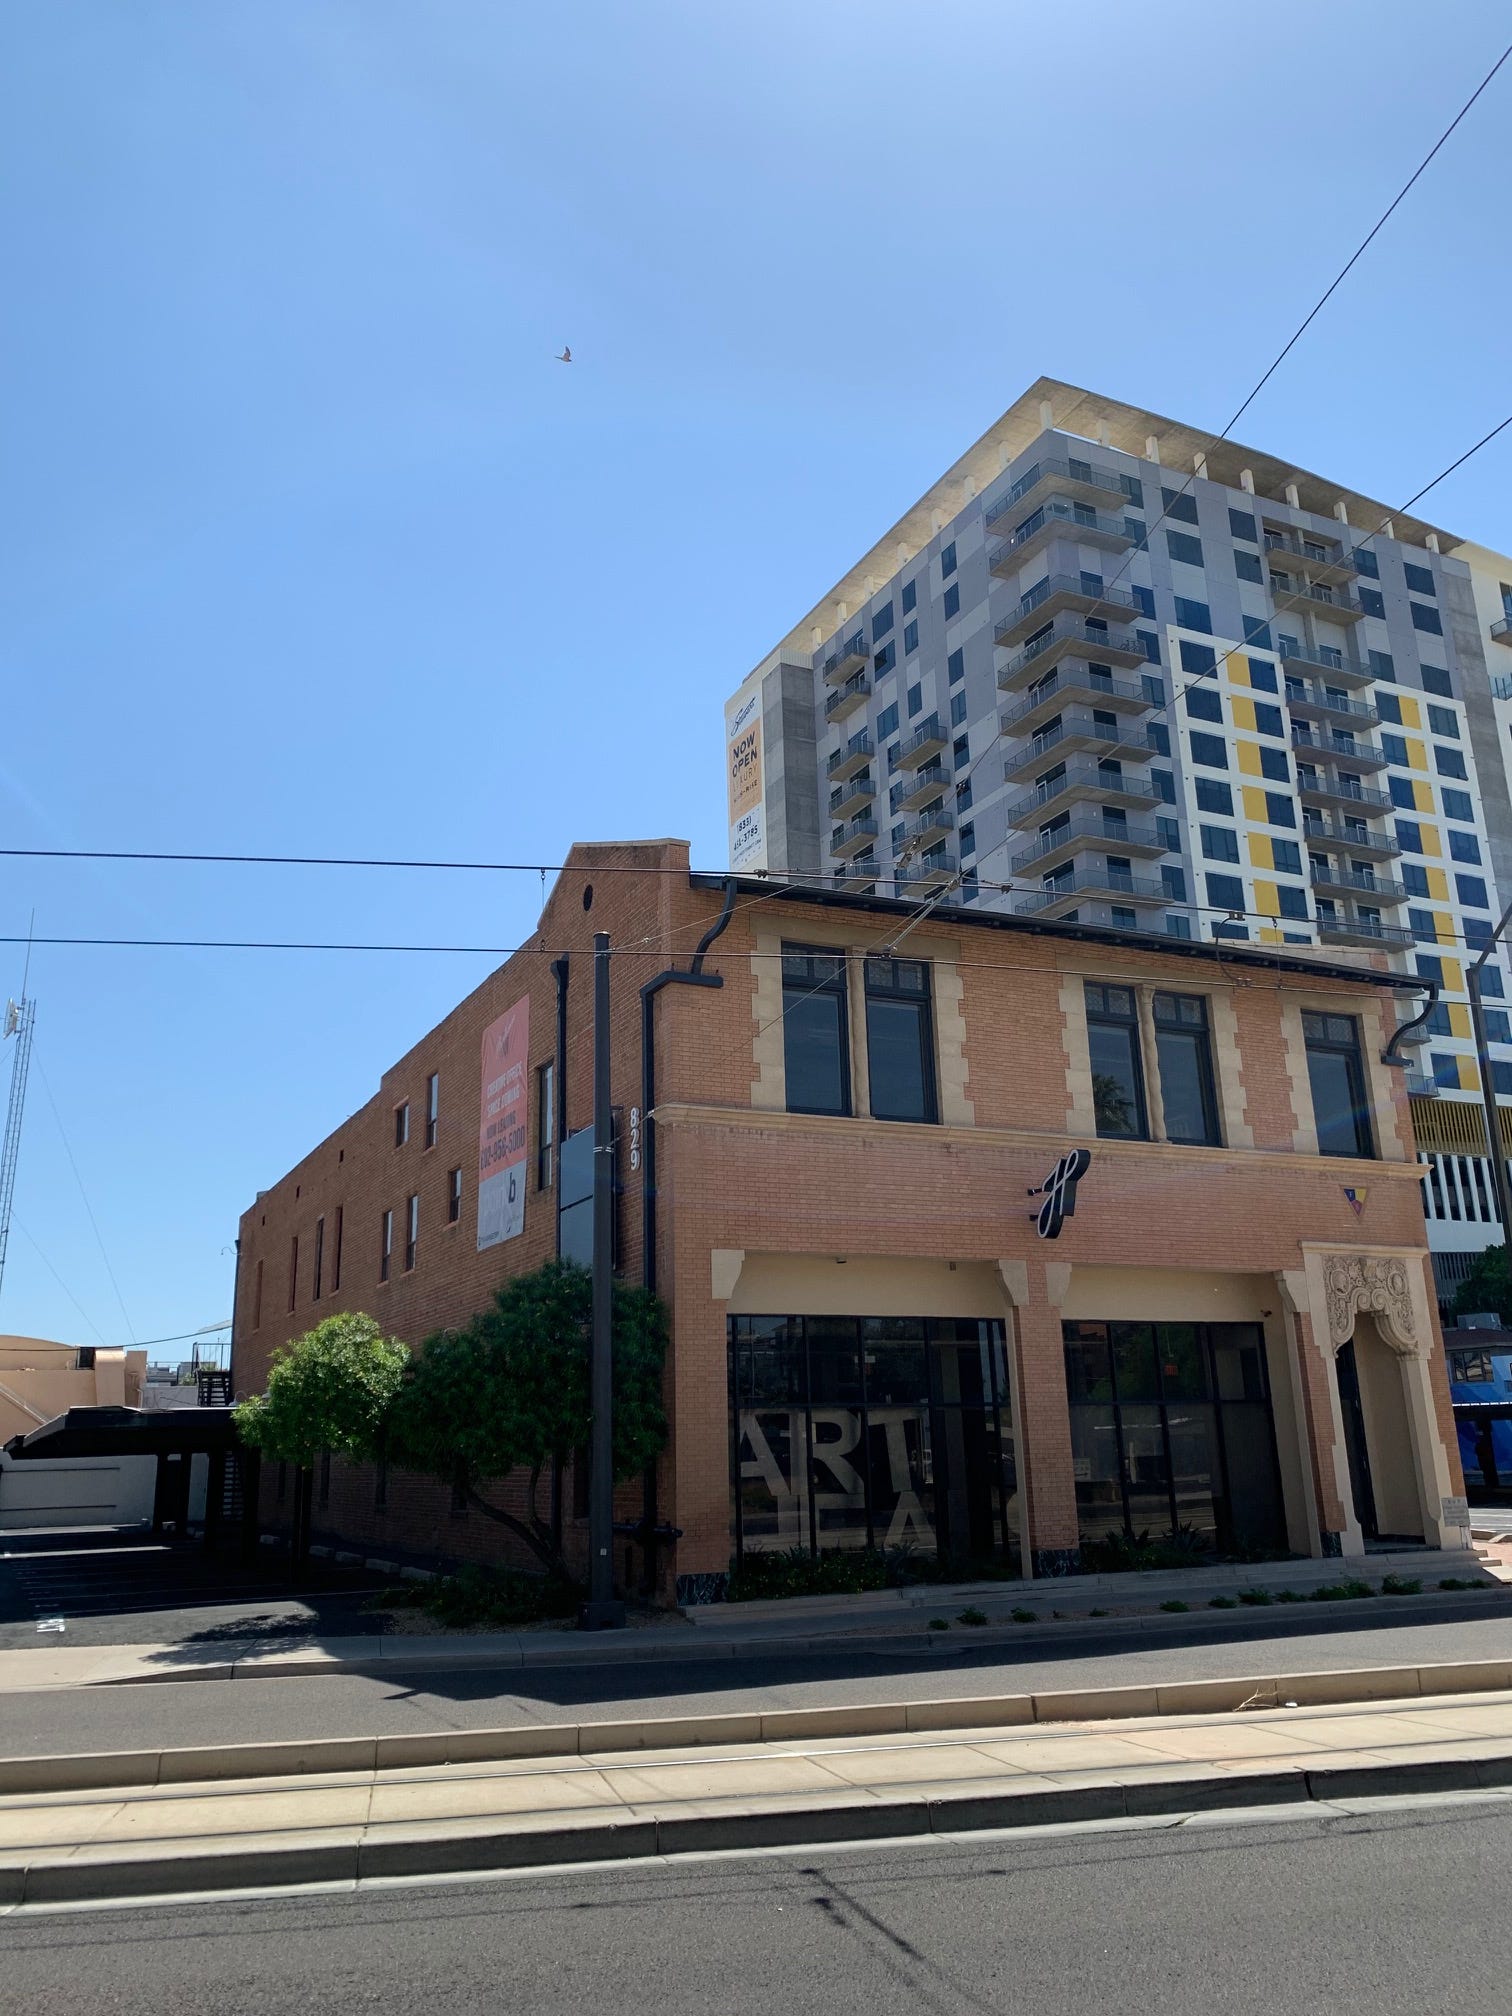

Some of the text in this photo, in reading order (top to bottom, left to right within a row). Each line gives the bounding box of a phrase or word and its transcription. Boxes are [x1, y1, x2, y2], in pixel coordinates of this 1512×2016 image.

[732, 747, 757, 777] OPEN
[733, 731, 755, 760] NOW
[630, 1106, 641, 1171] 829
[739, 1407, 930, 1496] ART
